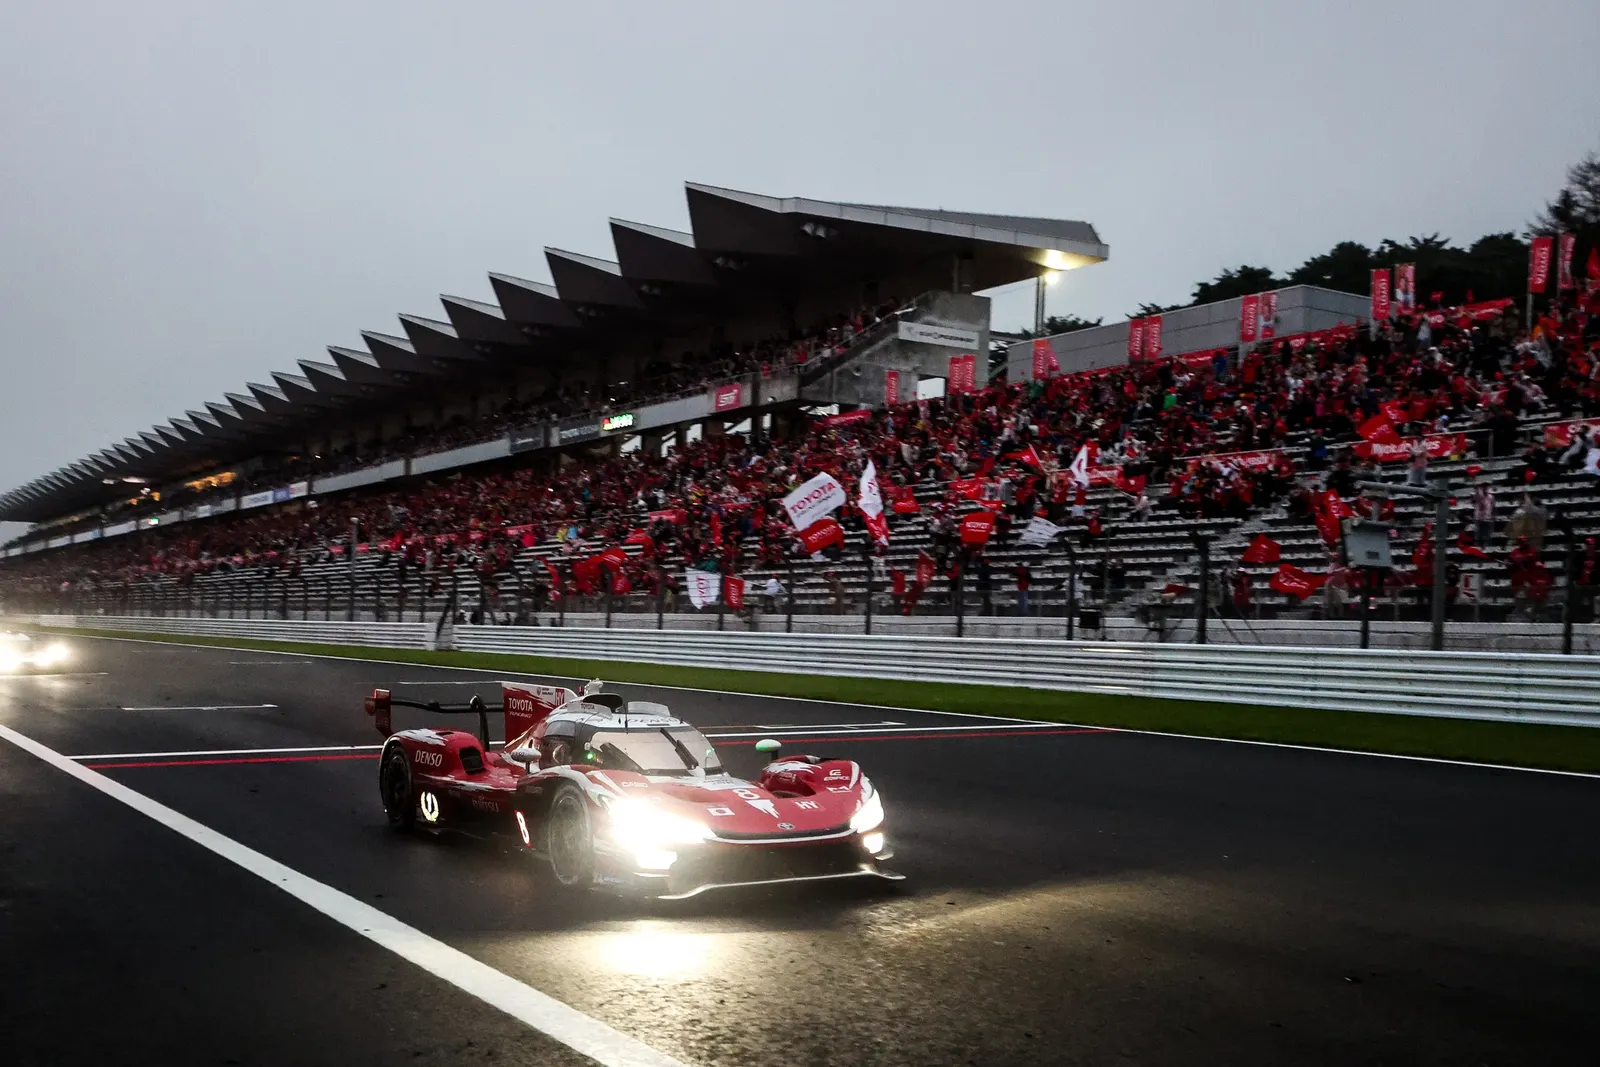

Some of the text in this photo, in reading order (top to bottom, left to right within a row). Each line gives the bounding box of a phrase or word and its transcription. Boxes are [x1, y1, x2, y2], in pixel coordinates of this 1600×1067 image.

[1533, 247, 1549, 285] TOYOTA
[790, 482, 836, 513] TOYOTA
[807, 524, 837, 543] TOYOTA
[508, 697, 533, 712] TOYOTA
[415, 750, 443, 767] DENSO
[733, 788, 760, 799] 8
[516, 811, 530, 844] 8
